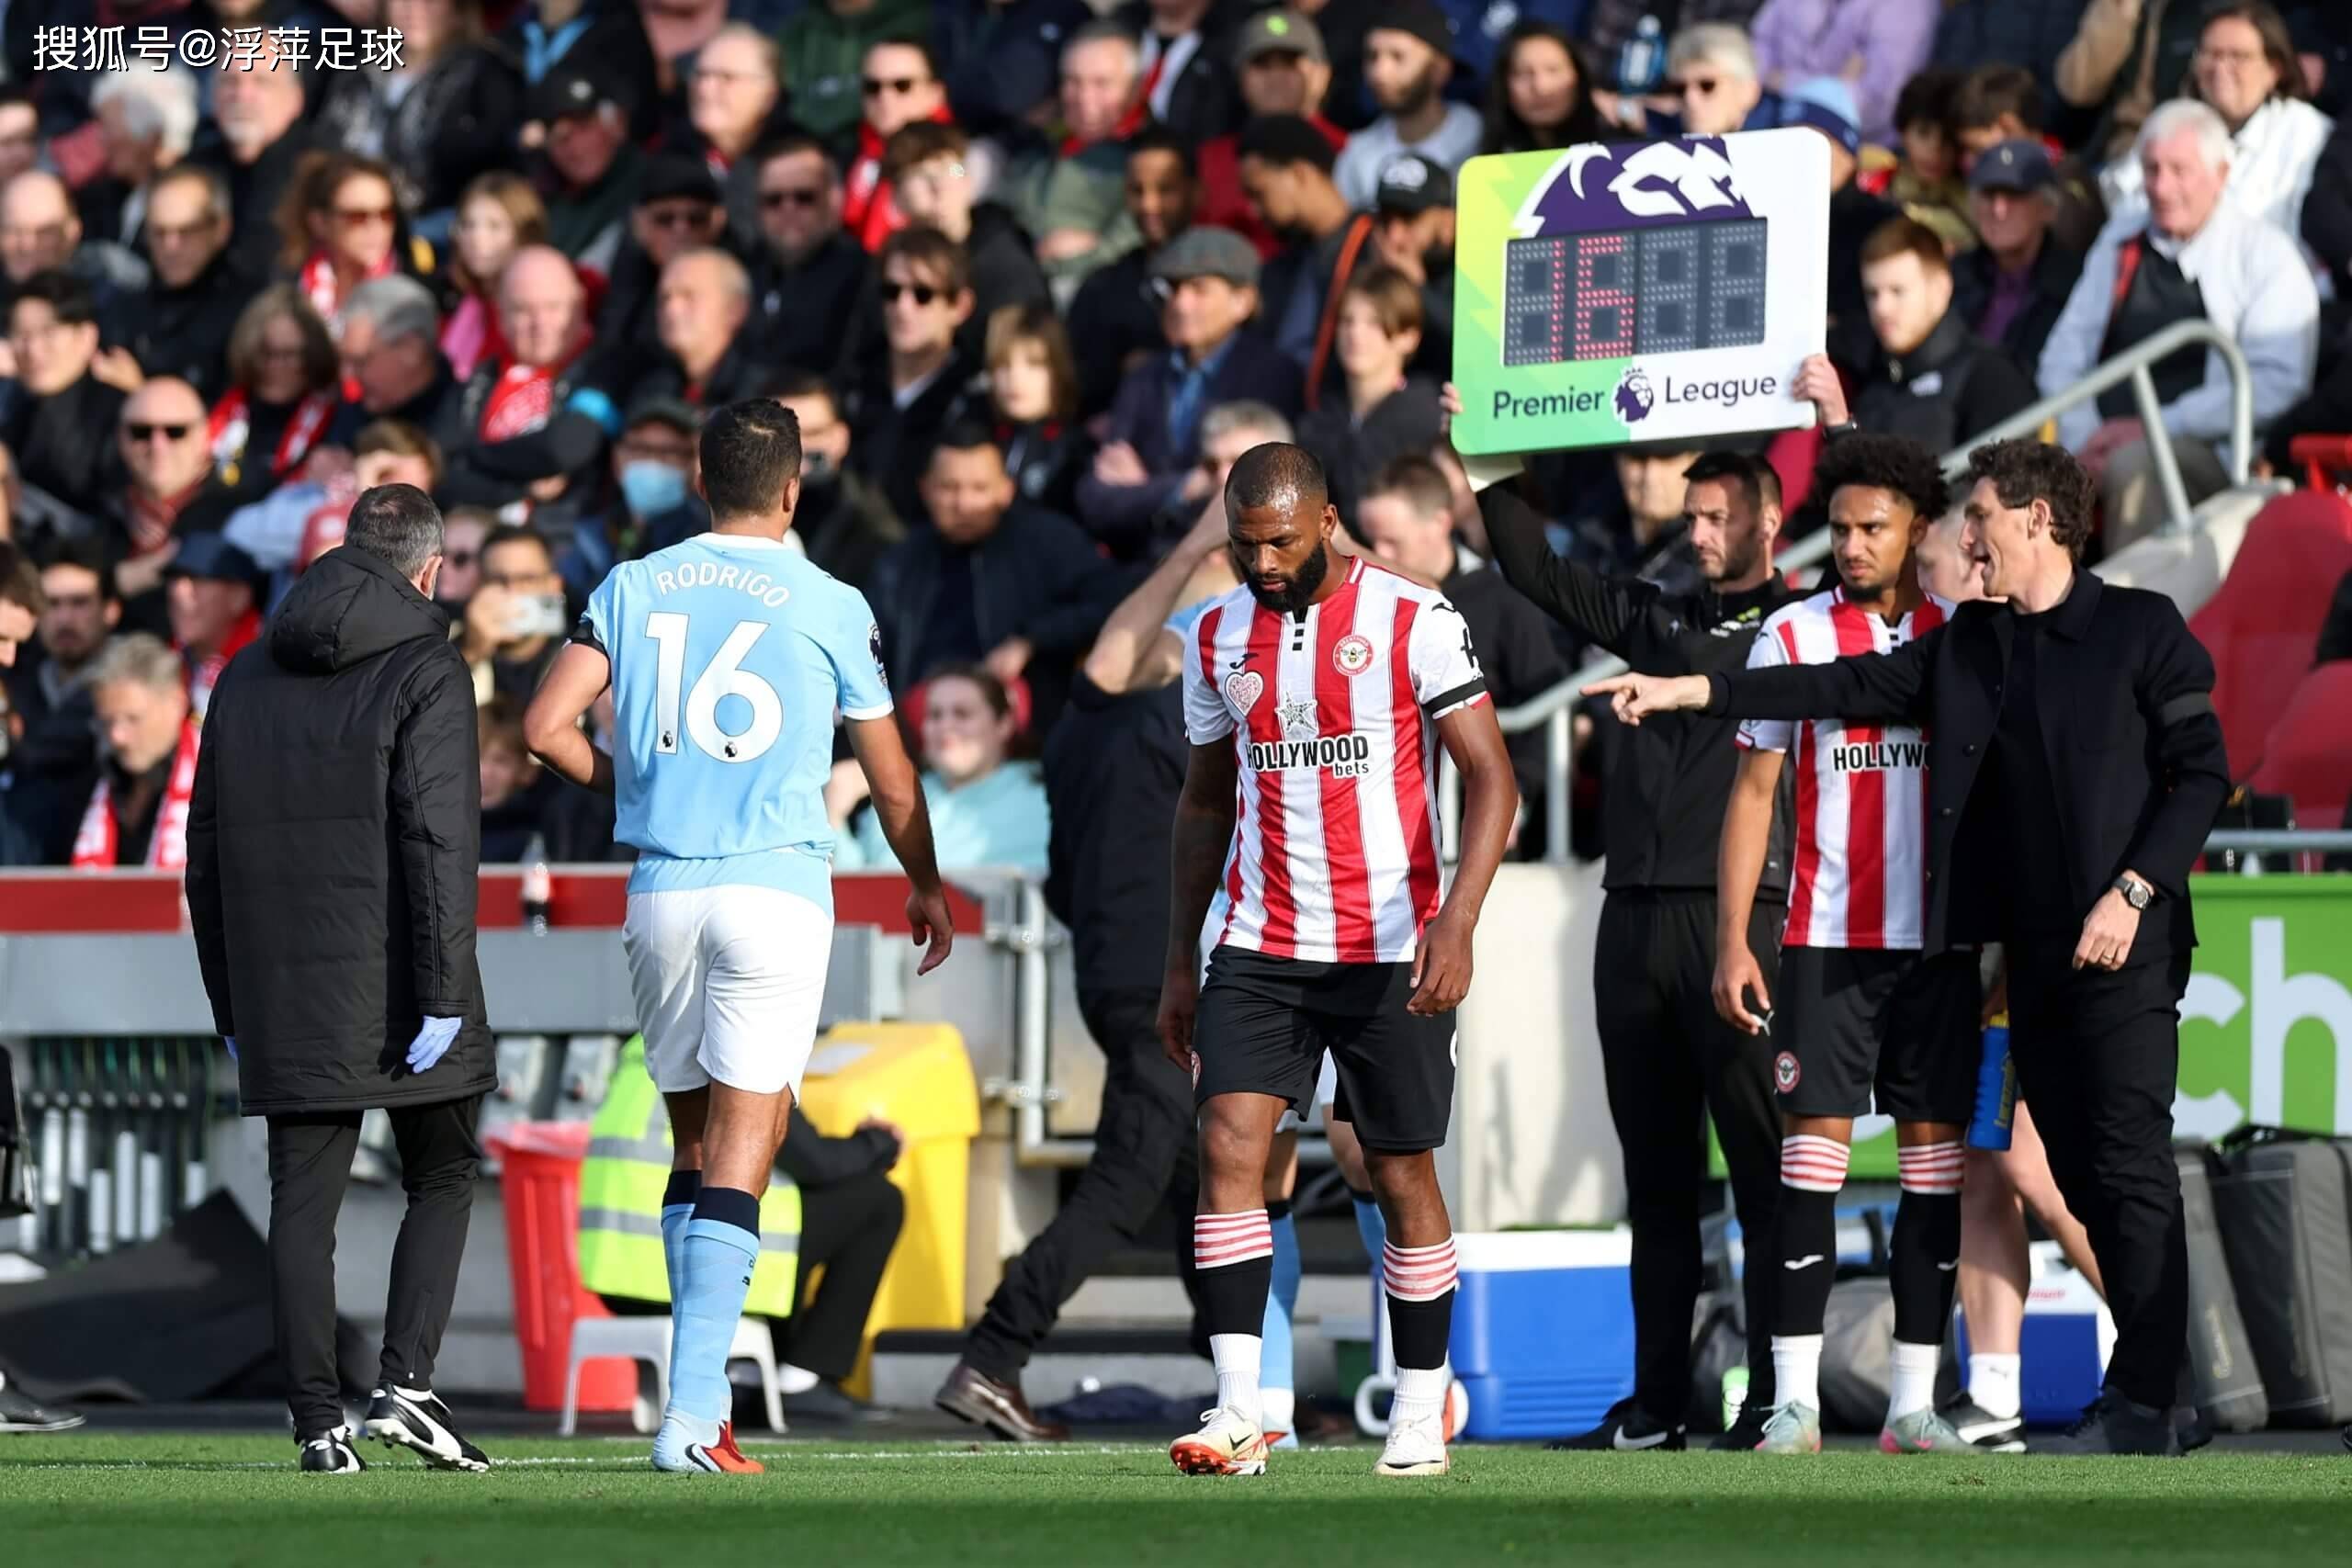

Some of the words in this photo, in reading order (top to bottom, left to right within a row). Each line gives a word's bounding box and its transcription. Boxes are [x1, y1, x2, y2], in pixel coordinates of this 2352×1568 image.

[1551, 235, 1634, 363] 16
[1492, 385, 1605, 419] Premier
[1665, 375, 1777, 406] League
[656, 561, 790, 608] RODRIGO
[645, 611, 784, 764] 16
[1245, 735, 1369, 770] HOLLYWOOD
[1335, 762, 1369, 776] bets
